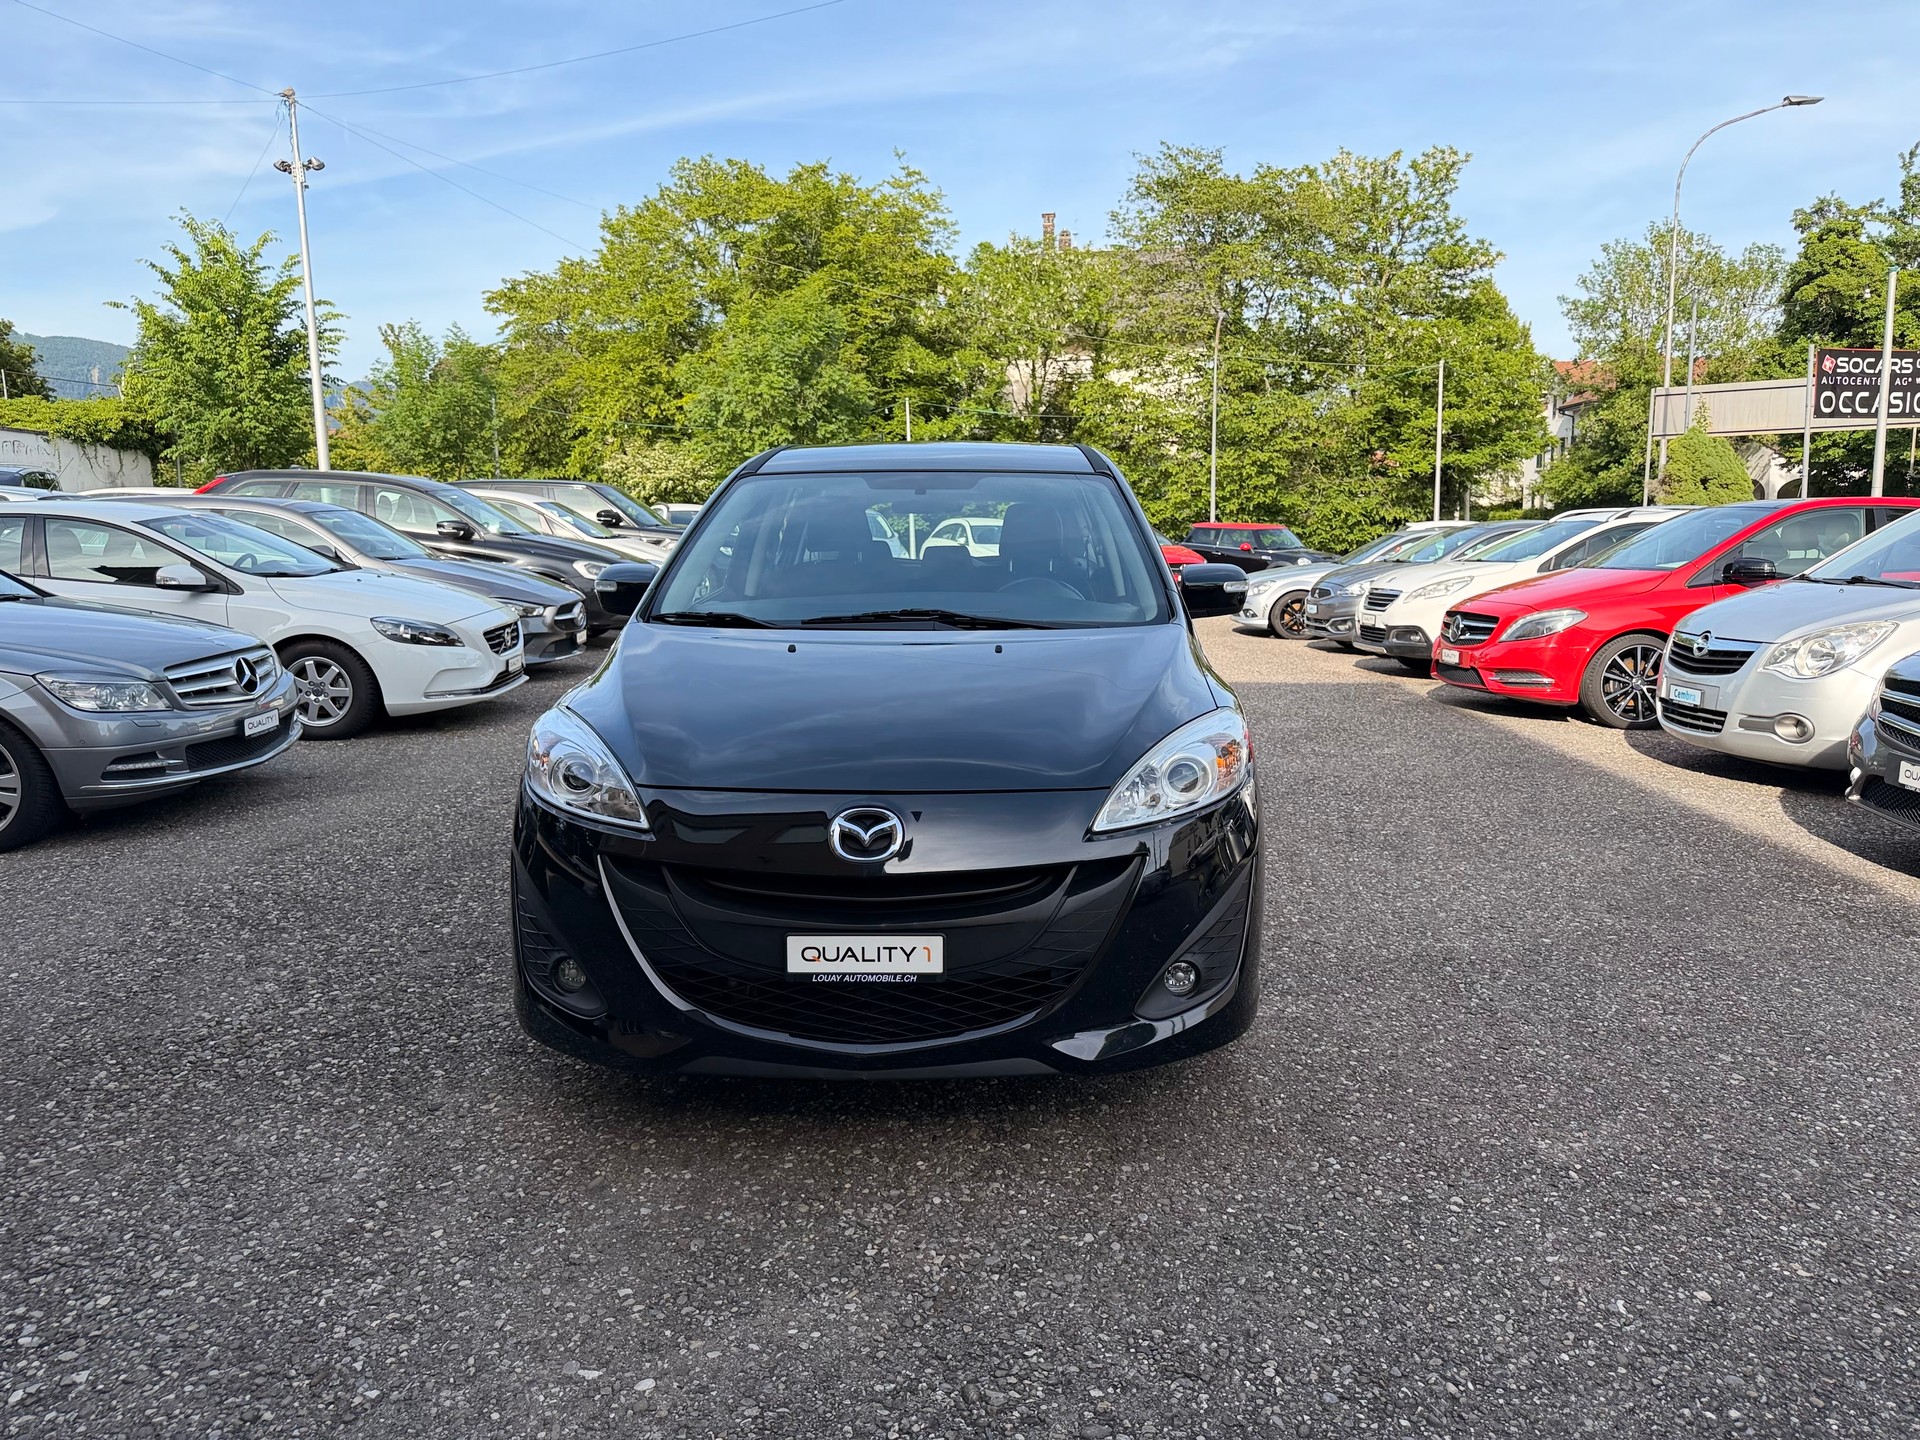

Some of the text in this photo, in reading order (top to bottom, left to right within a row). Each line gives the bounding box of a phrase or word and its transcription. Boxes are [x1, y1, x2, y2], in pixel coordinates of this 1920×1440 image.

[1821, 376, 1882, 385] AUTOCENTE
[1674, 689, 1697, 702] Cembra
[248, 715, 274, 730] QUALITY
[801, 946, 932, 963] QUALITY 1
[812, 974, 917, 983] LOUAY AUTOMOBILE.CH
